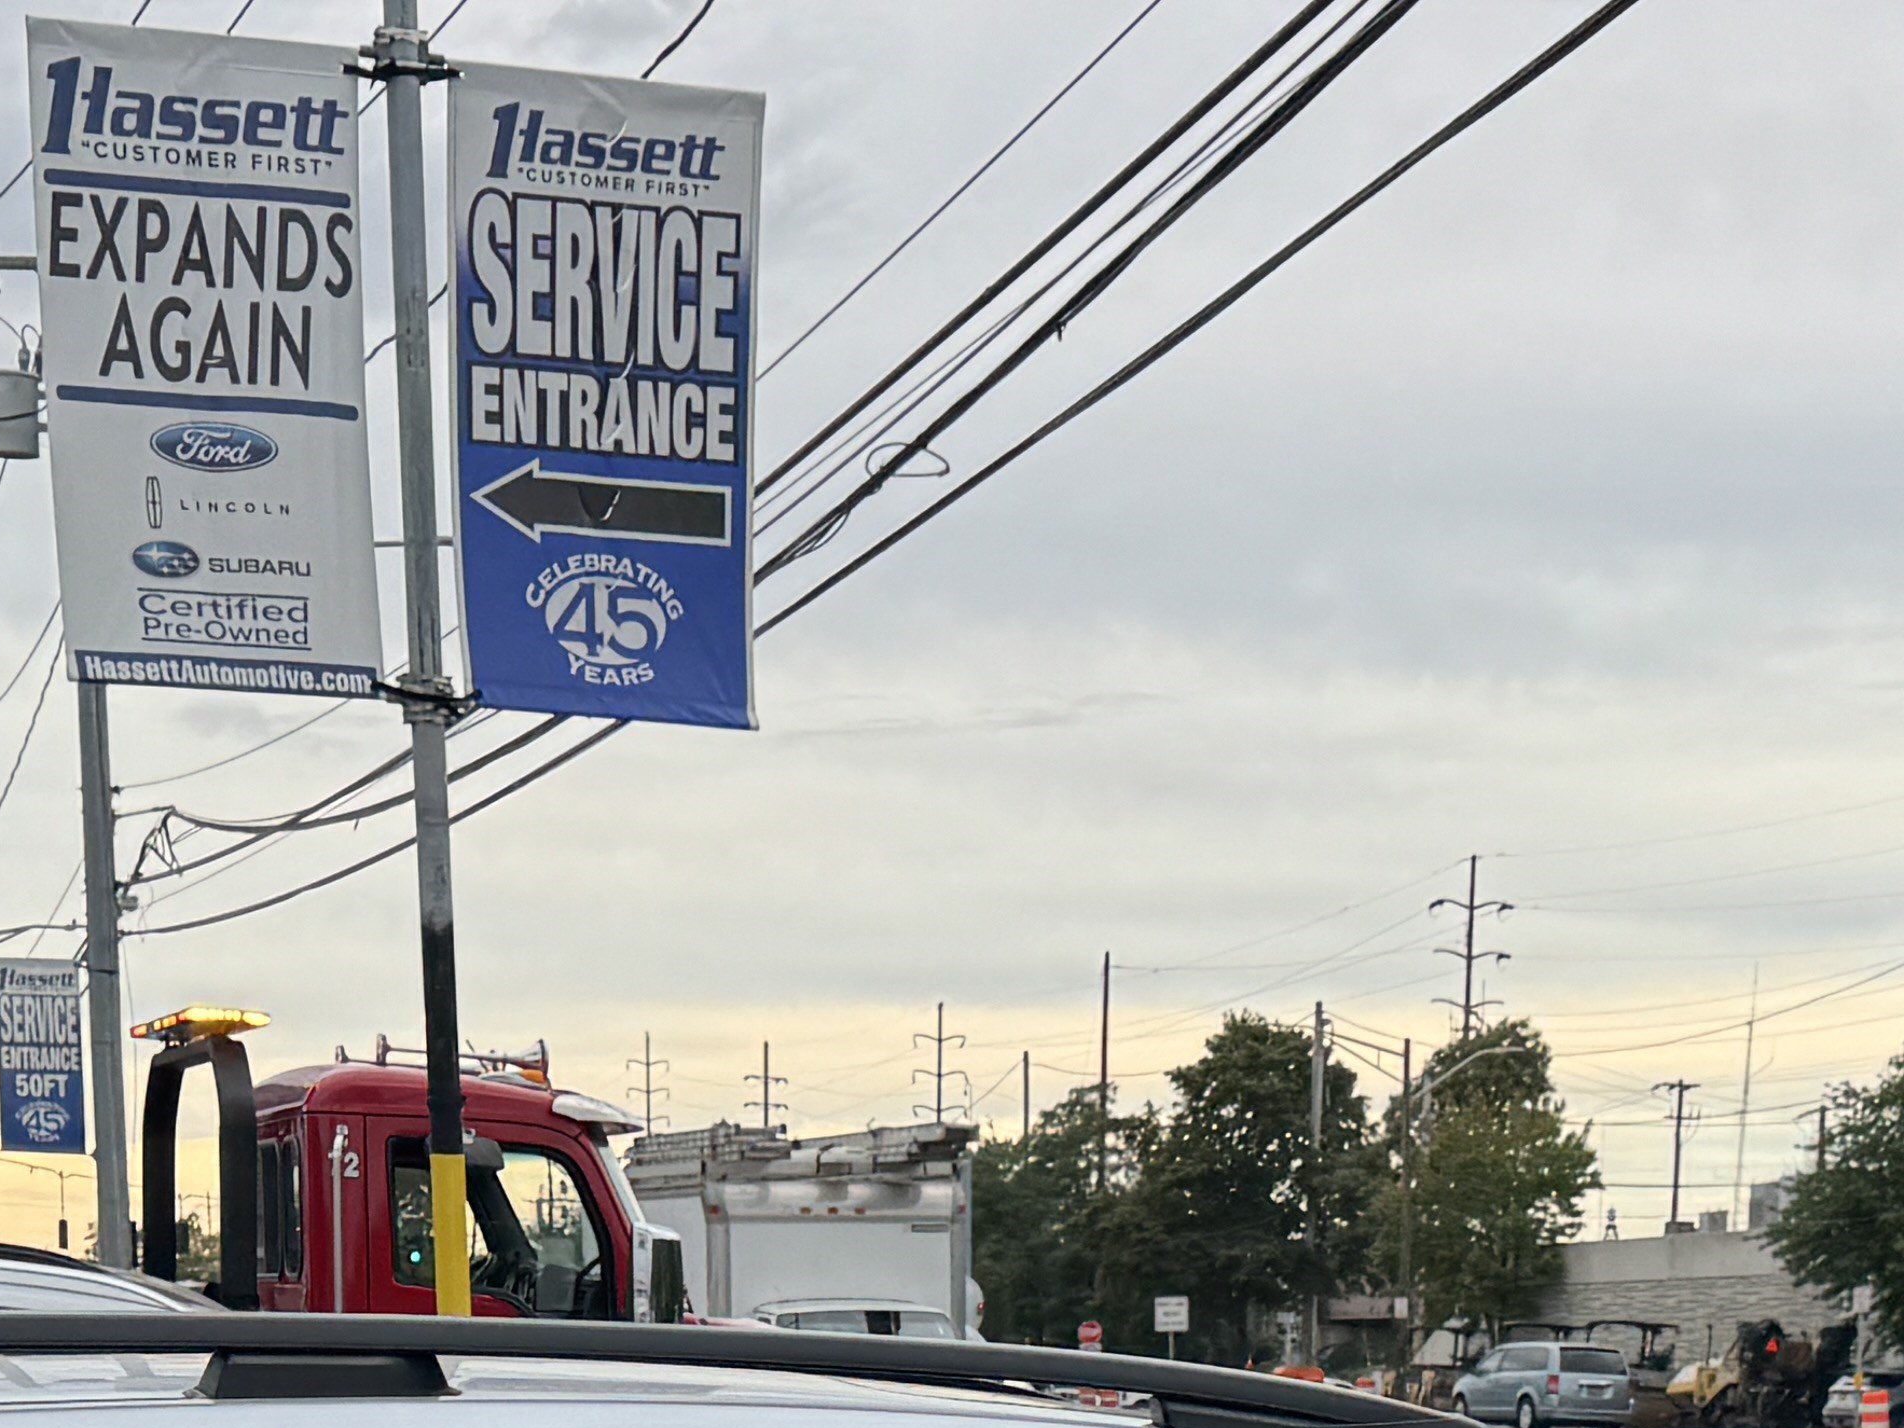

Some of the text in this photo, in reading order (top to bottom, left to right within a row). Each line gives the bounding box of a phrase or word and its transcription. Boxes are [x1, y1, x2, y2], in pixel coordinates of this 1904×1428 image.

[49, 191, 354, 299] EXPANDS
[468, 187, 742, 374] SERVICE
[98, 292, 312, 391] AGAIN
[469, 364, 737, 463] ENTRANCE
[175, 428, 252, 464] Ford
[180, 498, 291, 516] LINCOLN
[208, 557, 312, 577] SUBARU
[525, 553, 685, 621] CELEBRATING
[138, 592, 309, 624] Certified
[551, 580, 660, 661] 45
[143, 616, 309, 646] Pre-Owned
[84, 655, 372, 695] HassettAutomotive.com
[567, 652, 655, 686] YEARS
[0, 994, 79, 1045] SERVICE
[0, 1045, 81, 1072] ENTRANCE
[14, 1073, 69, 1098] 50FT
